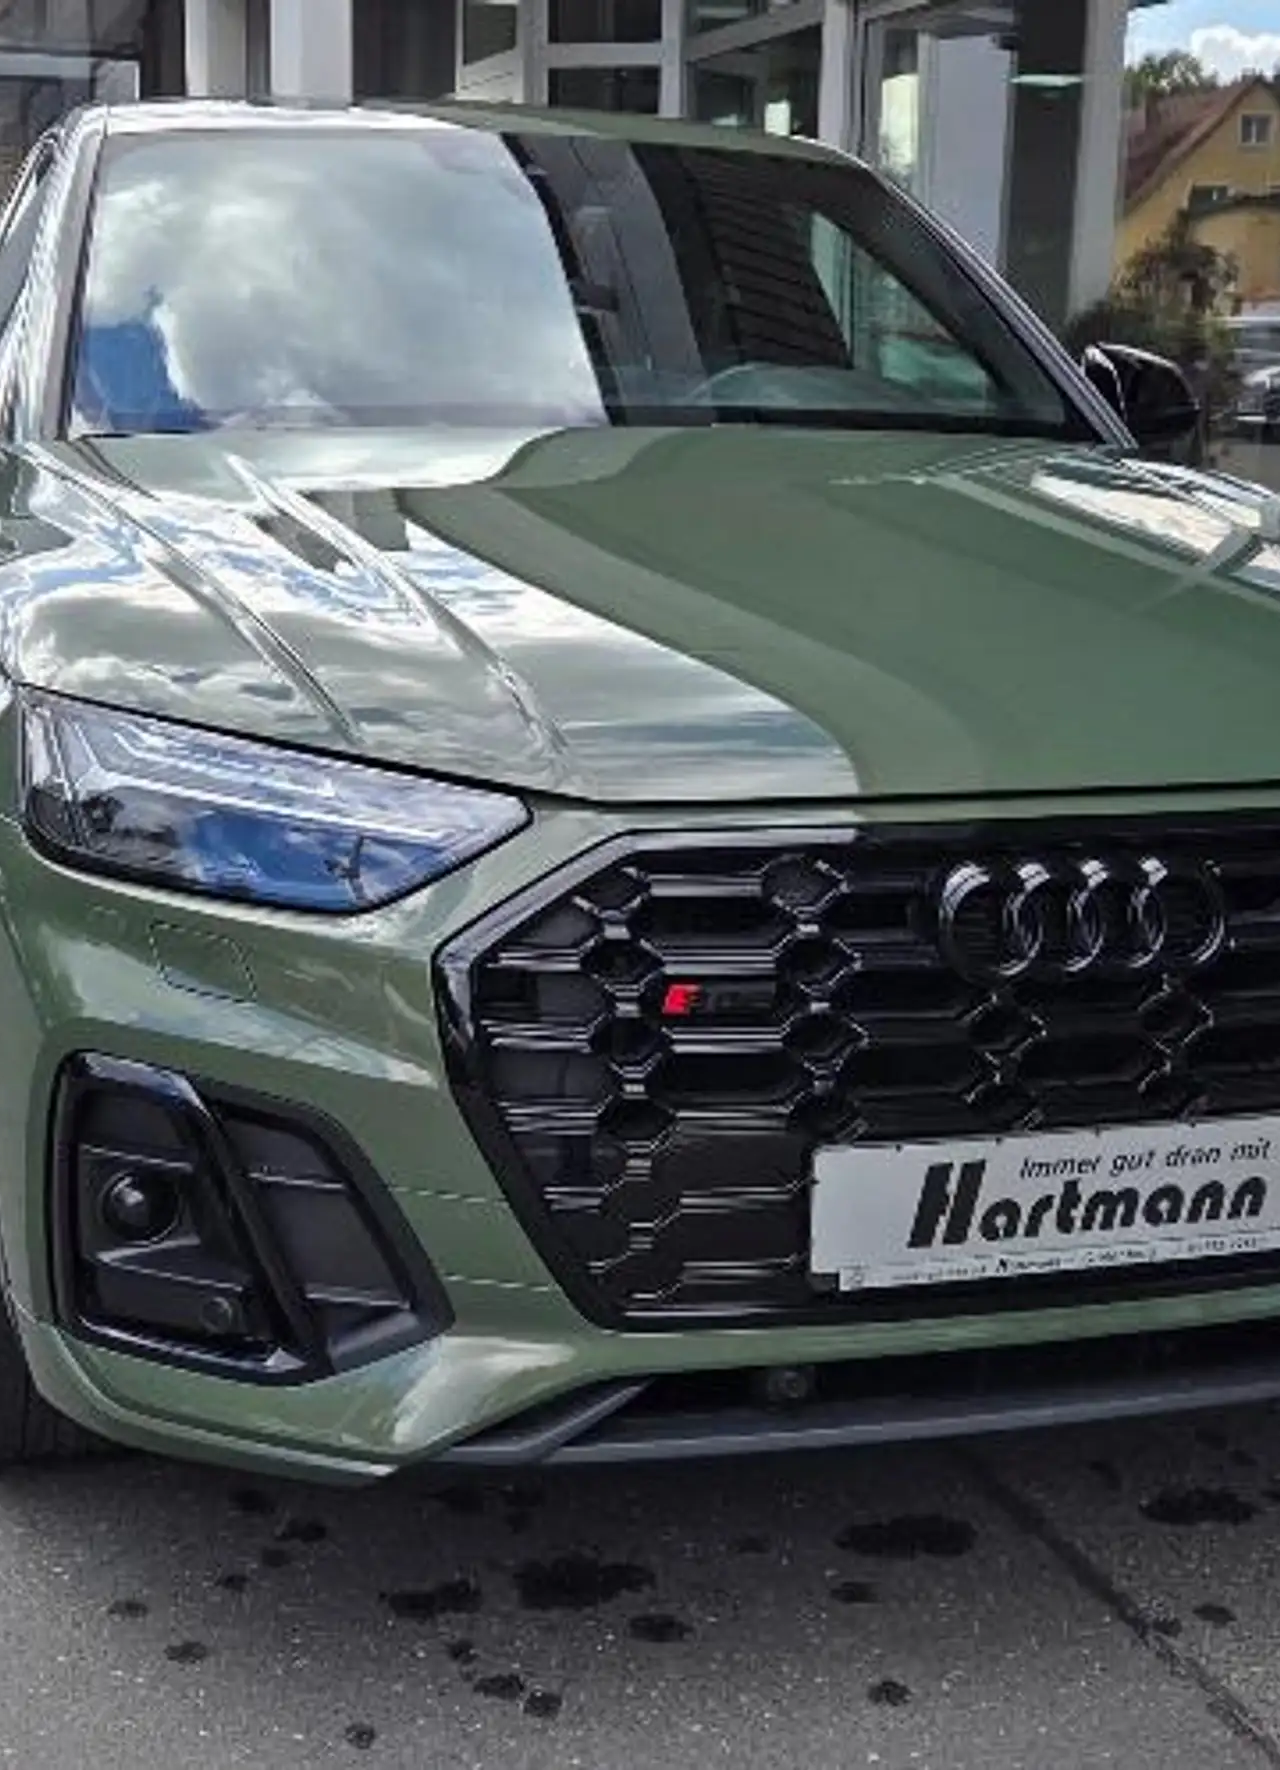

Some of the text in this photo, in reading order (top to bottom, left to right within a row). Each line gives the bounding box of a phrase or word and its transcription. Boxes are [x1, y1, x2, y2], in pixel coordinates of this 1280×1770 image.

[1109, 1149, 1156, 1178] gut
[1165, 1144, 1222, 1168] dran
[1229, 1137, 1272, 1160] mit
[906, 1158, 1268, 1249] Hartmann
